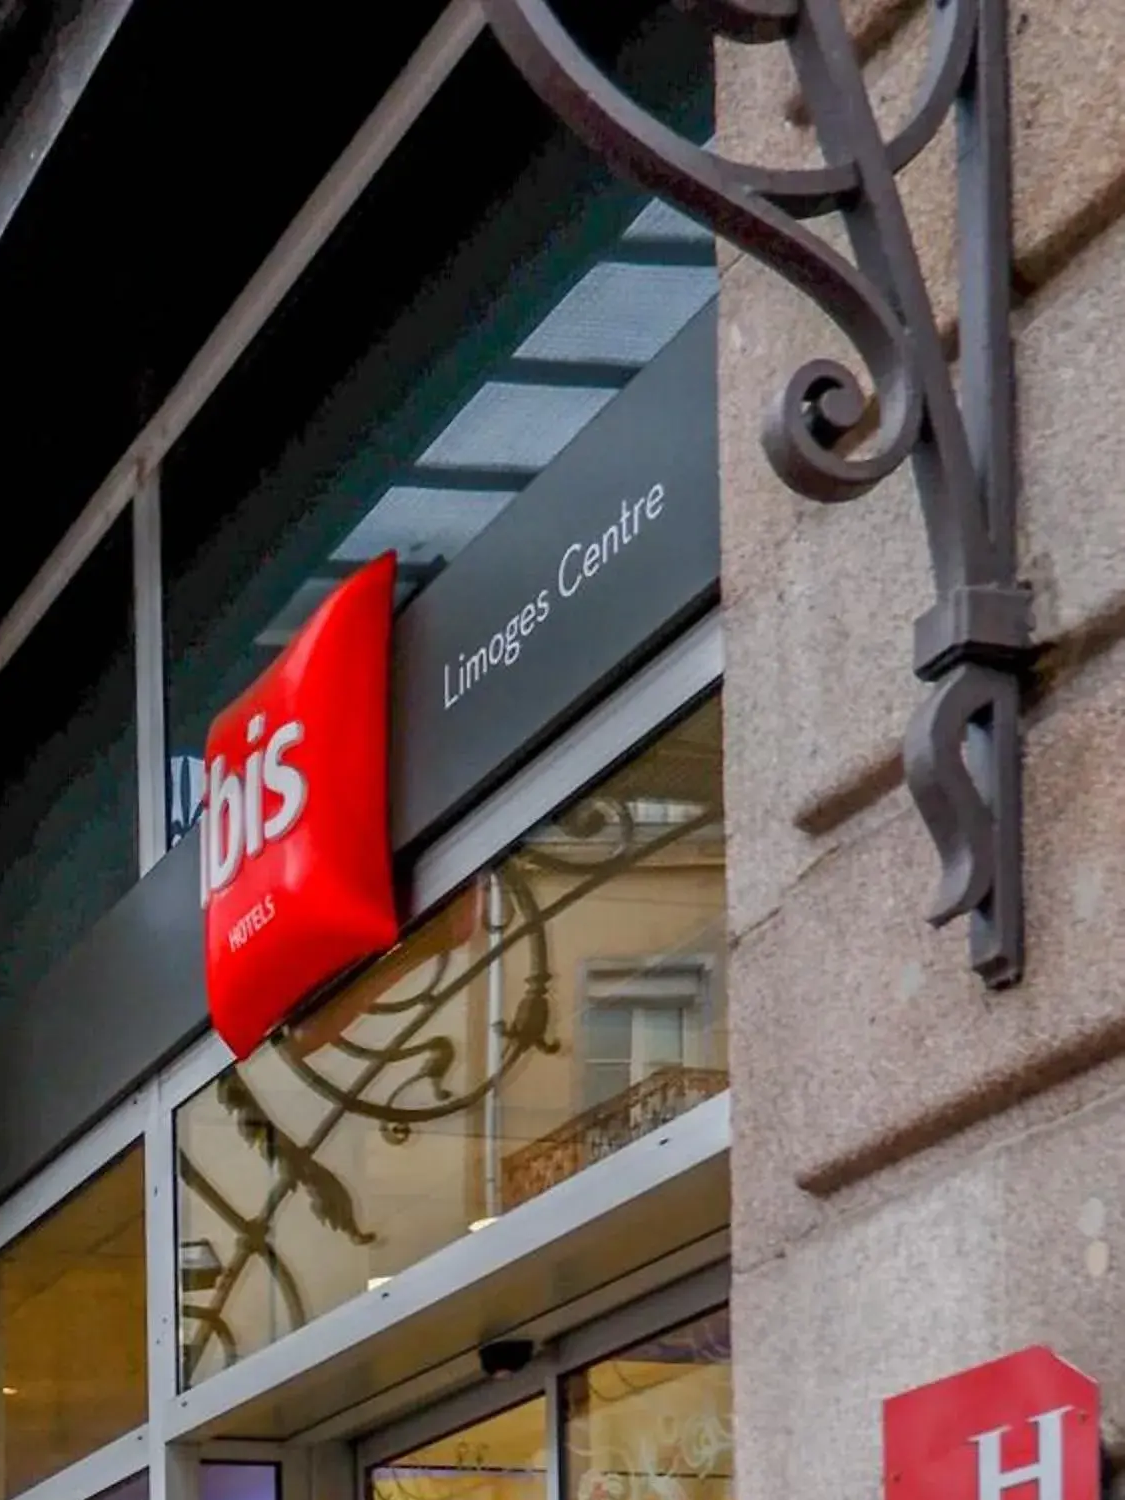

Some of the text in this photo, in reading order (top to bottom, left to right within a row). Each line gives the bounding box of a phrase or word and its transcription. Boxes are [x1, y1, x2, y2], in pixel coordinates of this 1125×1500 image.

[443, 482, 664, 709] Limoges Centre
[200, 713, 305, 910] ibis
[228, 894, 276, 952] HOTELS
